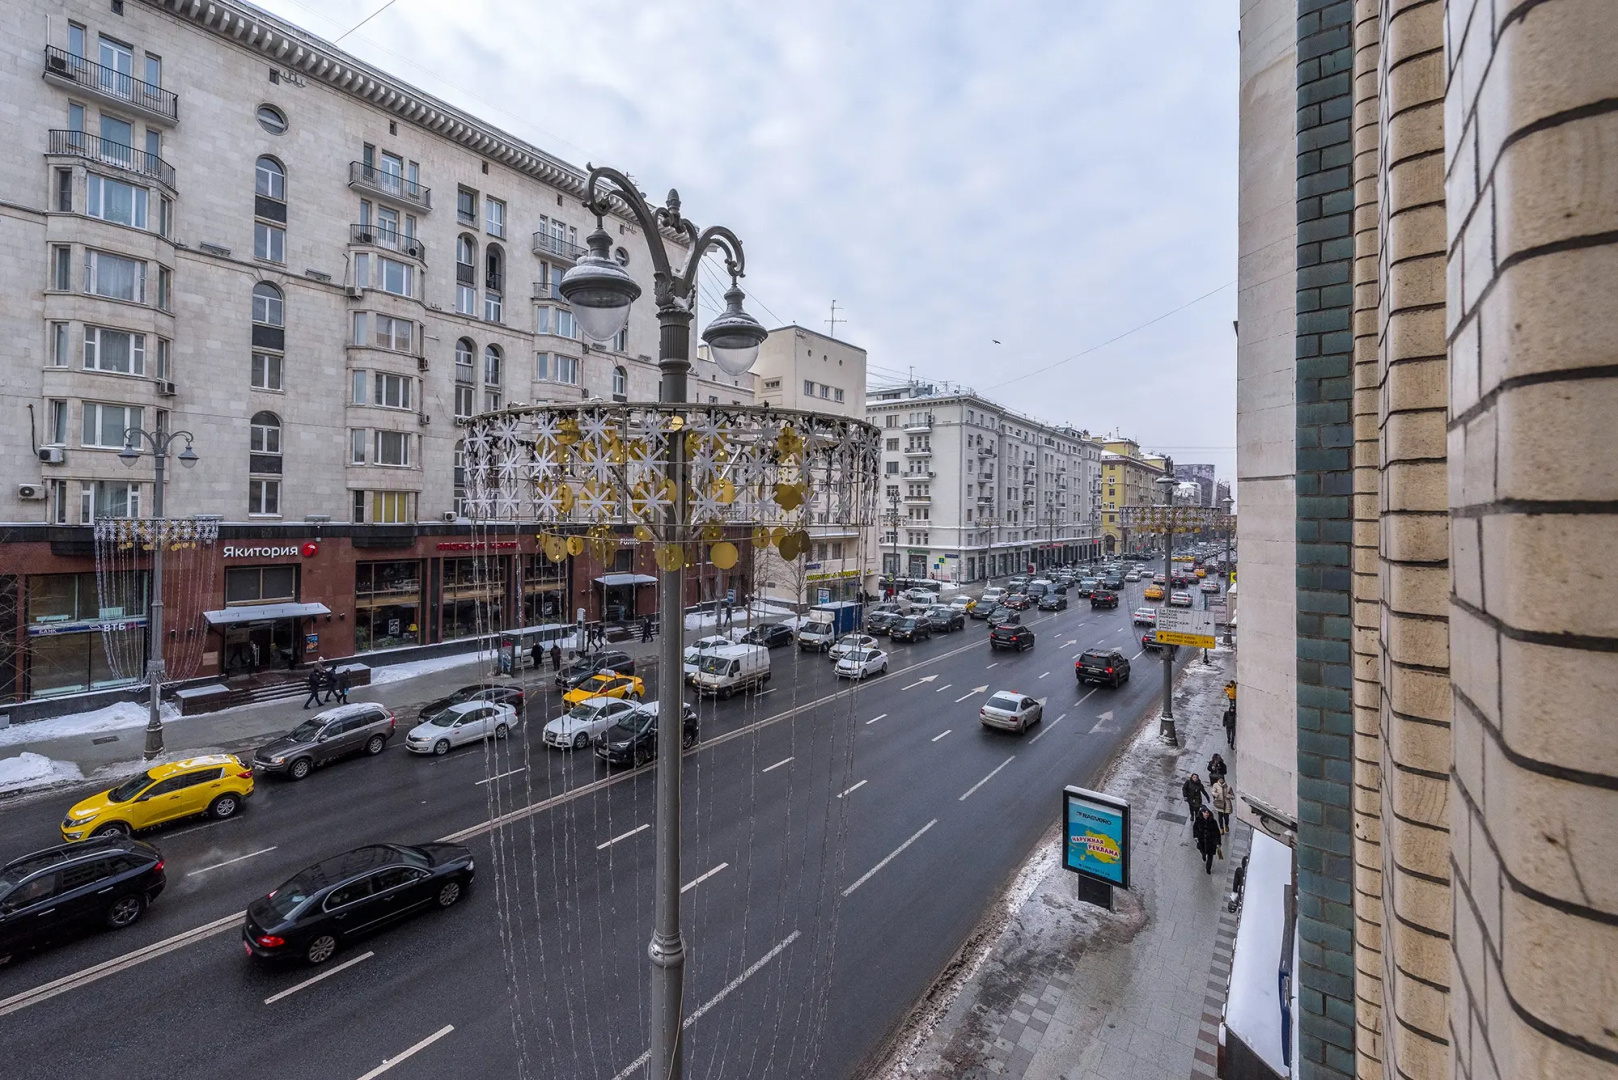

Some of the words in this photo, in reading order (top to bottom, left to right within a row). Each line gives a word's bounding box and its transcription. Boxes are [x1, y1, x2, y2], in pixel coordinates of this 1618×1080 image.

[223, 546, 298, 558] Якитория
[1072, 836, 1104, 845] НАРУЖНАЯ
[1088, 844, 1119, 857] РЕКЛАМА
